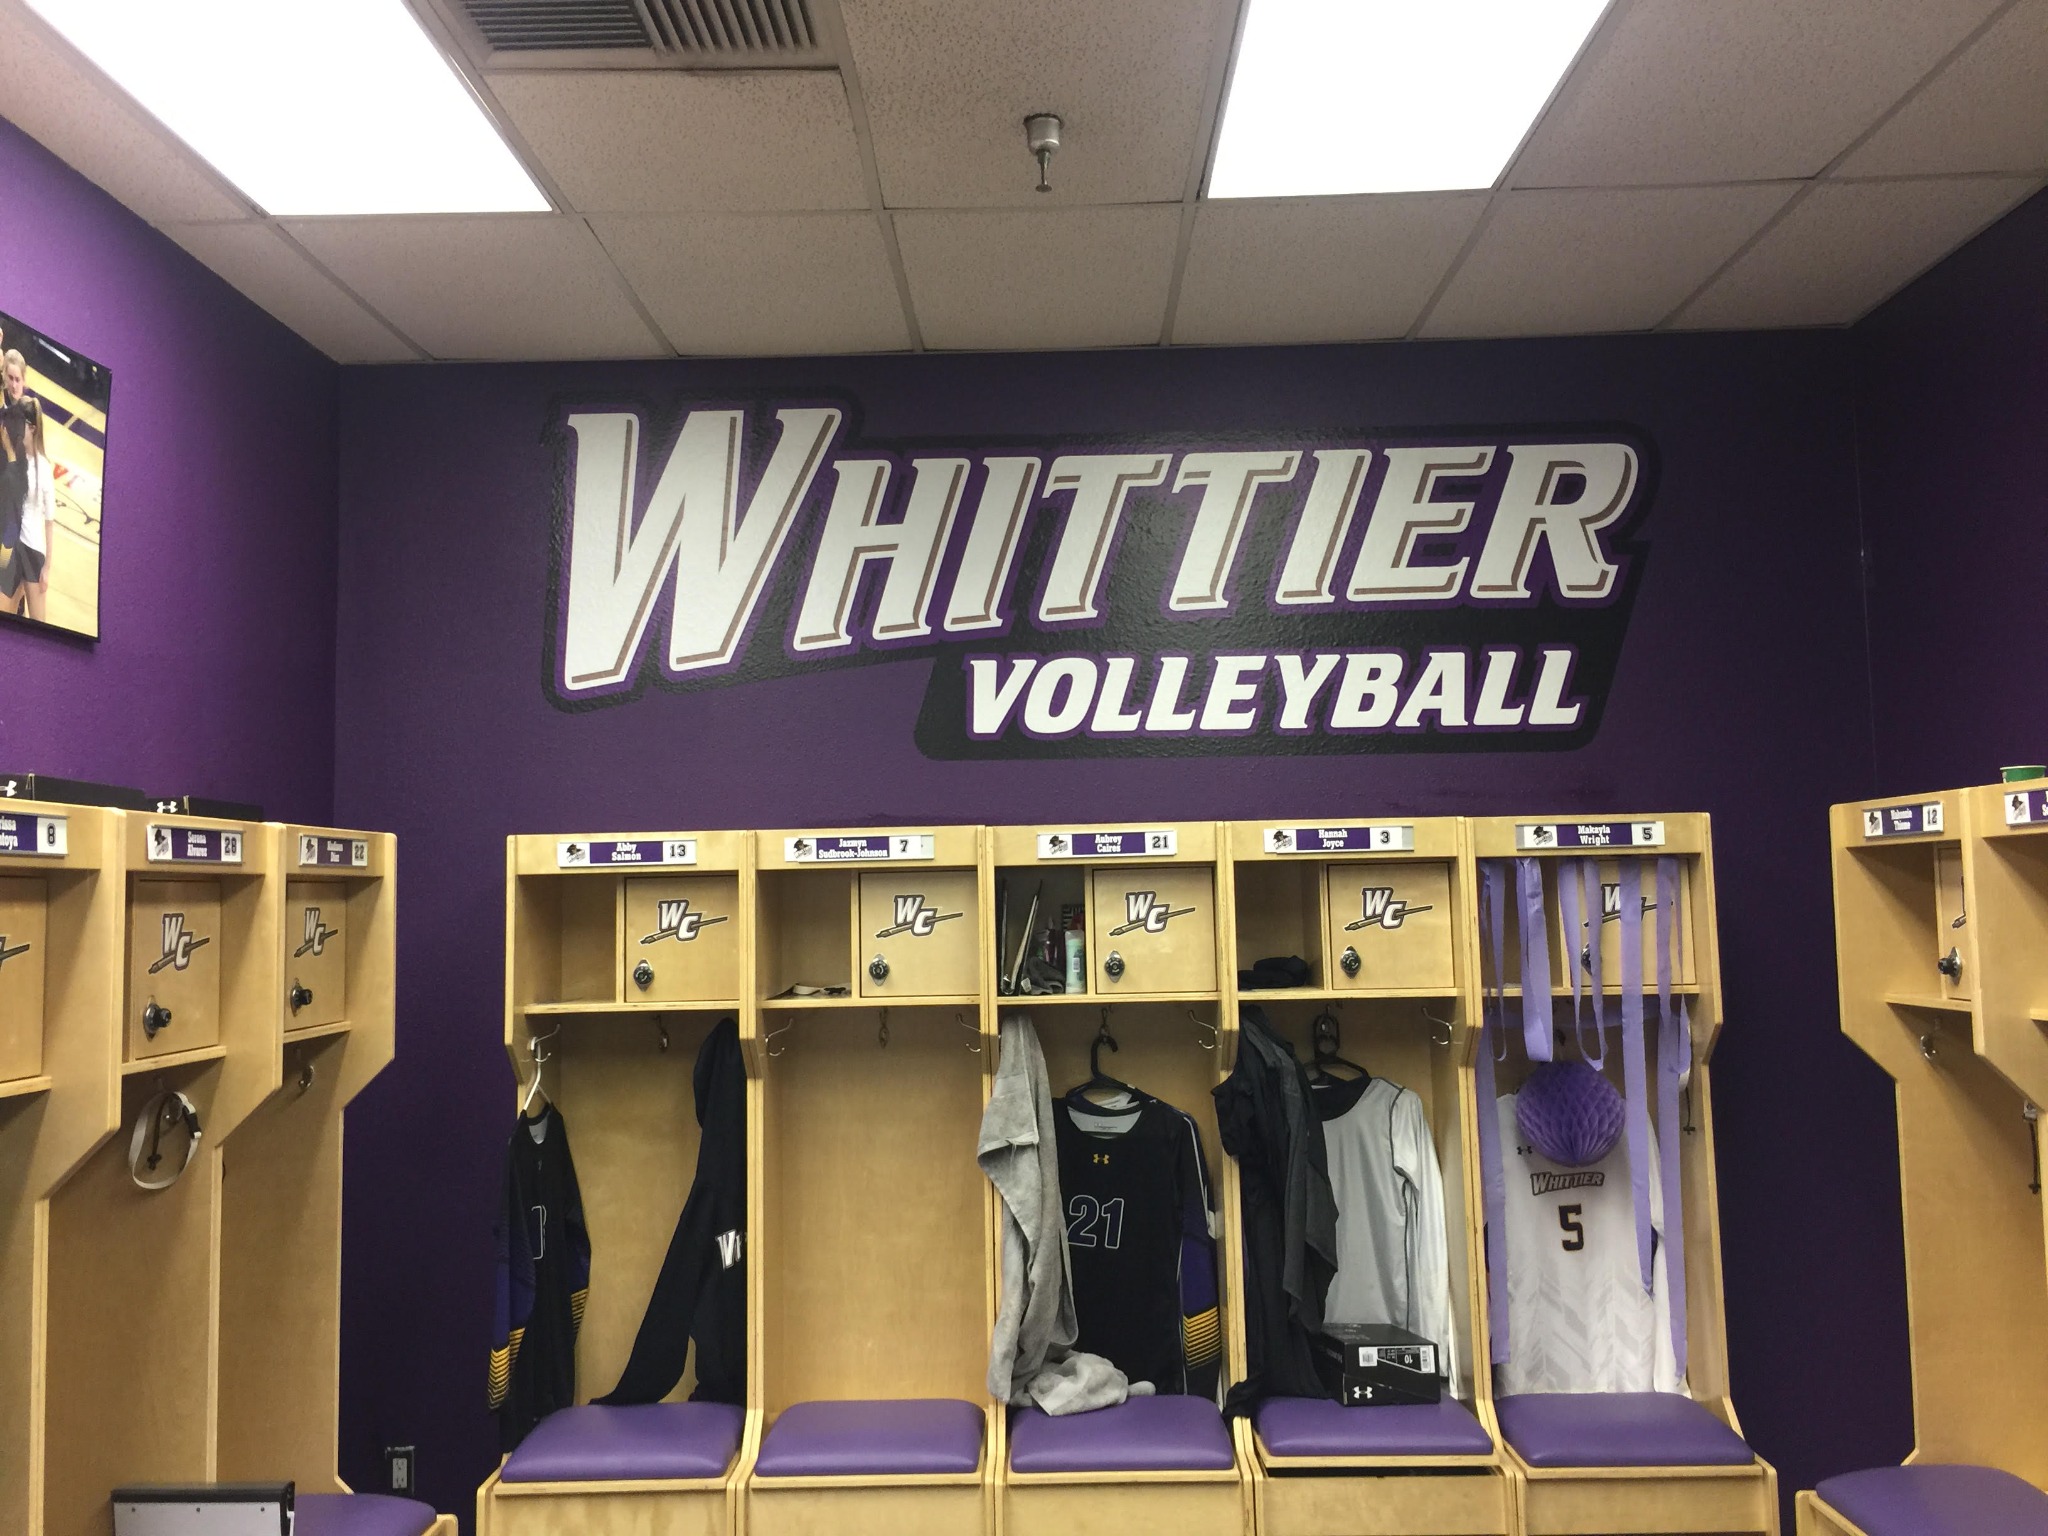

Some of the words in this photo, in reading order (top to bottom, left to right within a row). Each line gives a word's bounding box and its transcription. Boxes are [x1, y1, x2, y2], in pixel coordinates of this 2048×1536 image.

[564, 406, 1640, 692] WHITTIER
[969, 649, 1581, 736] VOLLEYBALL
[1927, 808, 1938, 826] 12
[47, 822, 56, 847] 8
[1318, 829, 1348, 838] Hannah
[1380, 831, 1390, 844] 3
[1577, 825, 1611, 836] Makayla
[1642, 827, 1653, 841] 5
[225, 836, 237, 856] 28
[616, 842, 637, 853] Abby
[838, 838, 867, 850] Jazmyn
[900, 839, 908, 853] 7
[1095, 834, 1123, 846] Aubrey
[1152, 835, 1169, 849] 21
[1322, 838, 1344, 849] Joyce
[1580, 835, 1610, 846] Wright
[670, 844, 686, 858] 13
[818, 848, 888, 859] Sudbrook-Johnson
[894, 894, 938, 936] WC
[1125, 890, 1170, 933] WC
[1362, 887, 1407, 930] WC
[658, 899, 702, 941] WC
[304, 907, 326, 956] WC
[162, 912, 193, 971] WC
[1067, 1194, 1124, 1249] 21
[1558, 1203, 1584, 1251] 5
